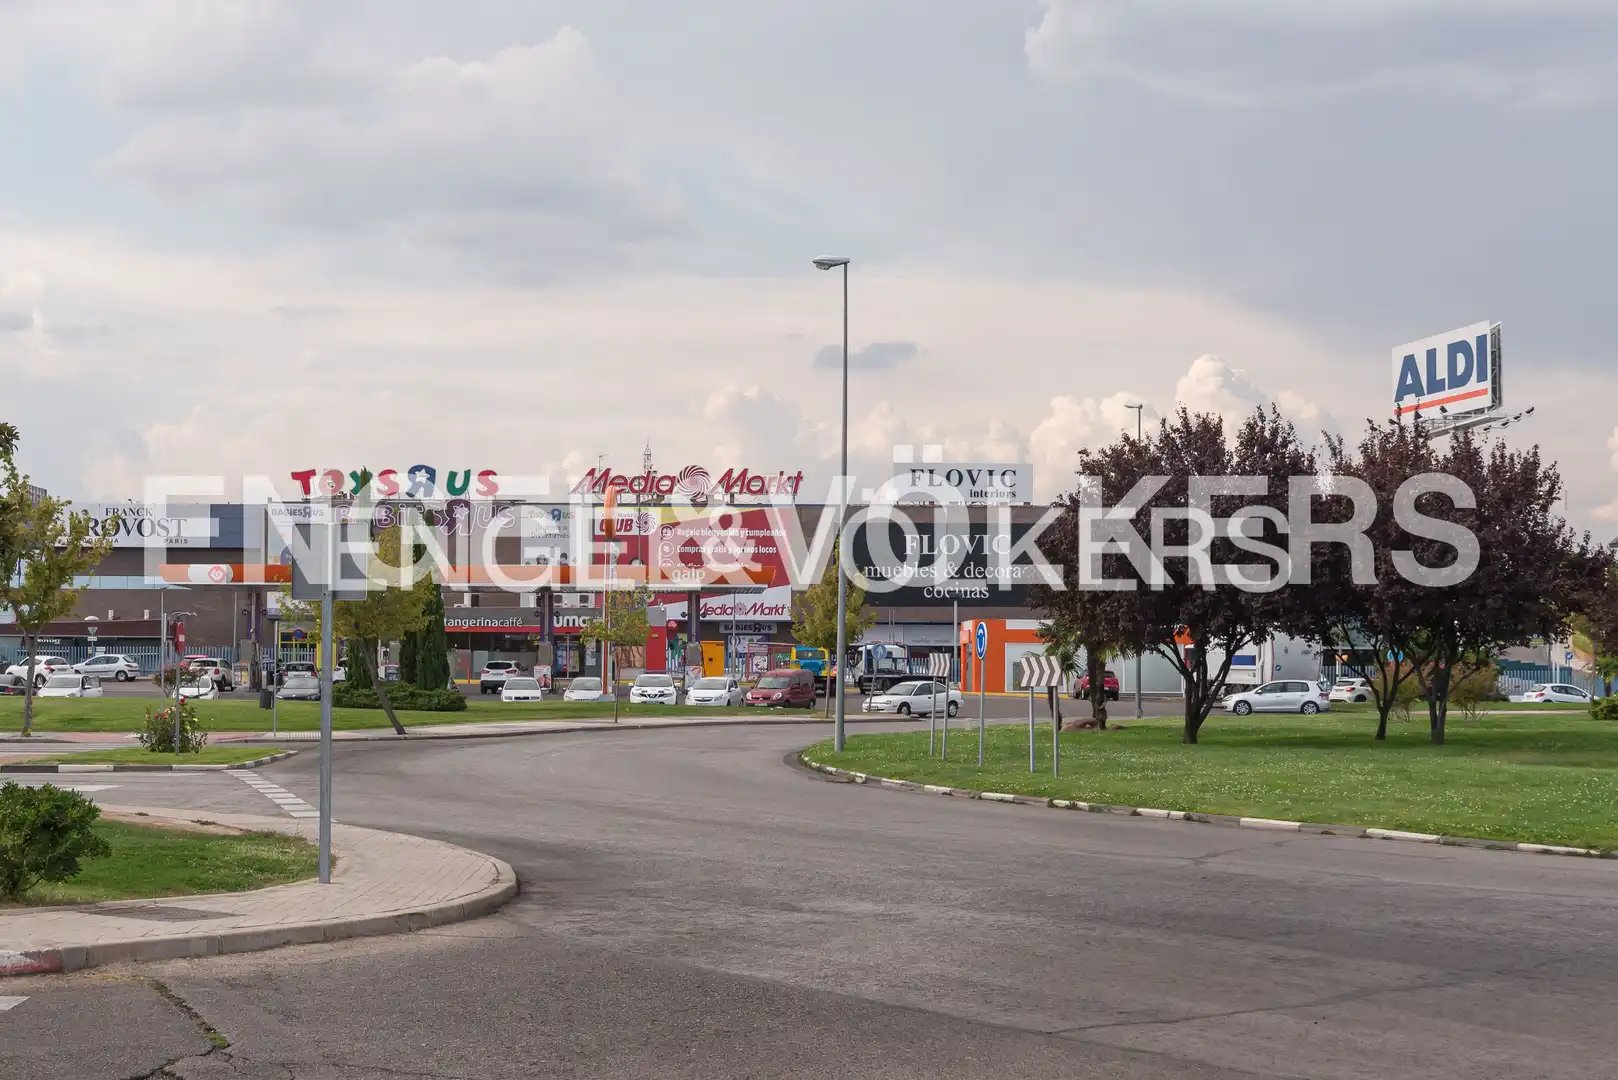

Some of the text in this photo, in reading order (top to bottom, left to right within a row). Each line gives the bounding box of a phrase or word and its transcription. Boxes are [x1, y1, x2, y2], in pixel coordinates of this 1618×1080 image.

[1394, 333, 1487, 403] ALDI
[569, 467, 803, 494] Media Markt
[910, 468, 1017, 488] FLOVIC
[969, 488, 1017, 498] interiors
[105, 507, 153, 516] FRANCK
[70, 518, 188, 537] ROVOST
[599, 518, 634, 532] CUB
[676, 528, 700, 538] Regalo
[759, 545, 777, 554] locos
[903, 534, 1012, 556] FLOVIC
[671, 568, 706, 583] galp
[864, 562, 937, 578] muebles
[944, 562, 960, 578] &
[924, 582, 989, 598] cocinas
[744, 602, 786, 616] Markt
